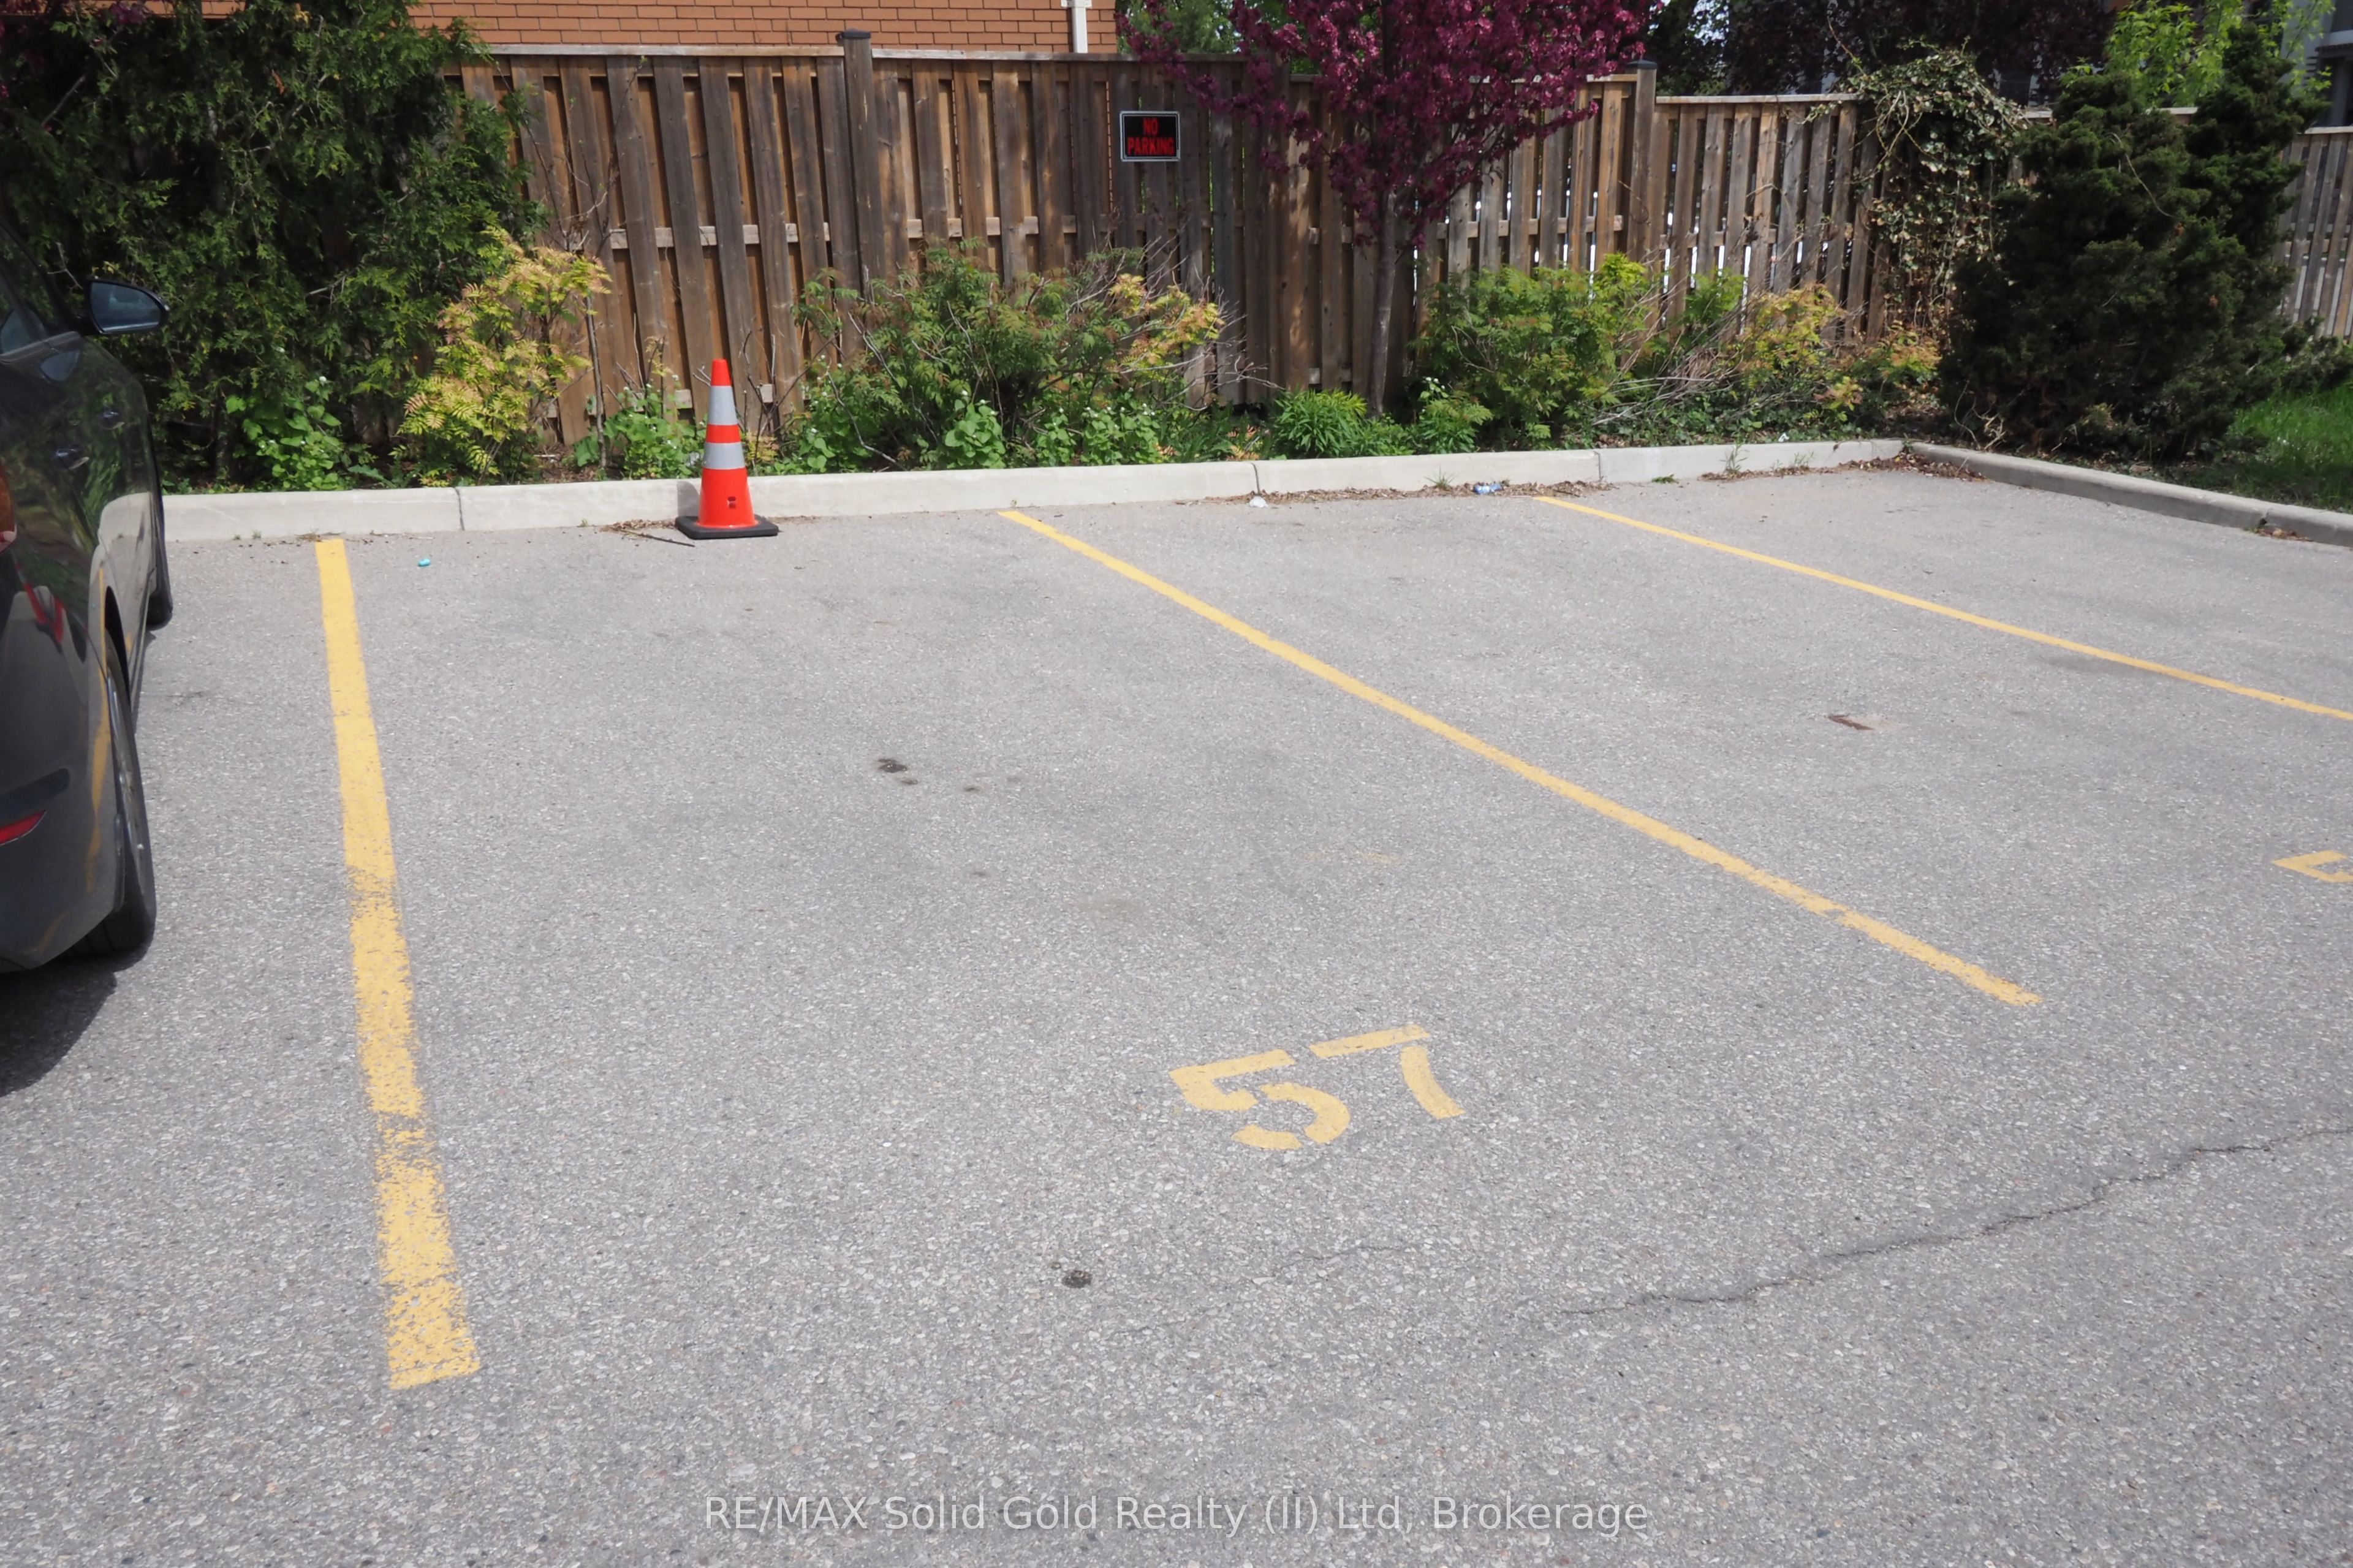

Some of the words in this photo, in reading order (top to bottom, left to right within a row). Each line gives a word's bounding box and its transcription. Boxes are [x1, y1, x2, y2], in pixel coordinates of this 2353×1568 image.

[1143, 117, 1159, 135] NO
[1127, 137, 1175, 155] PARKING
[1168, 1024, 1466, 1150] 57
